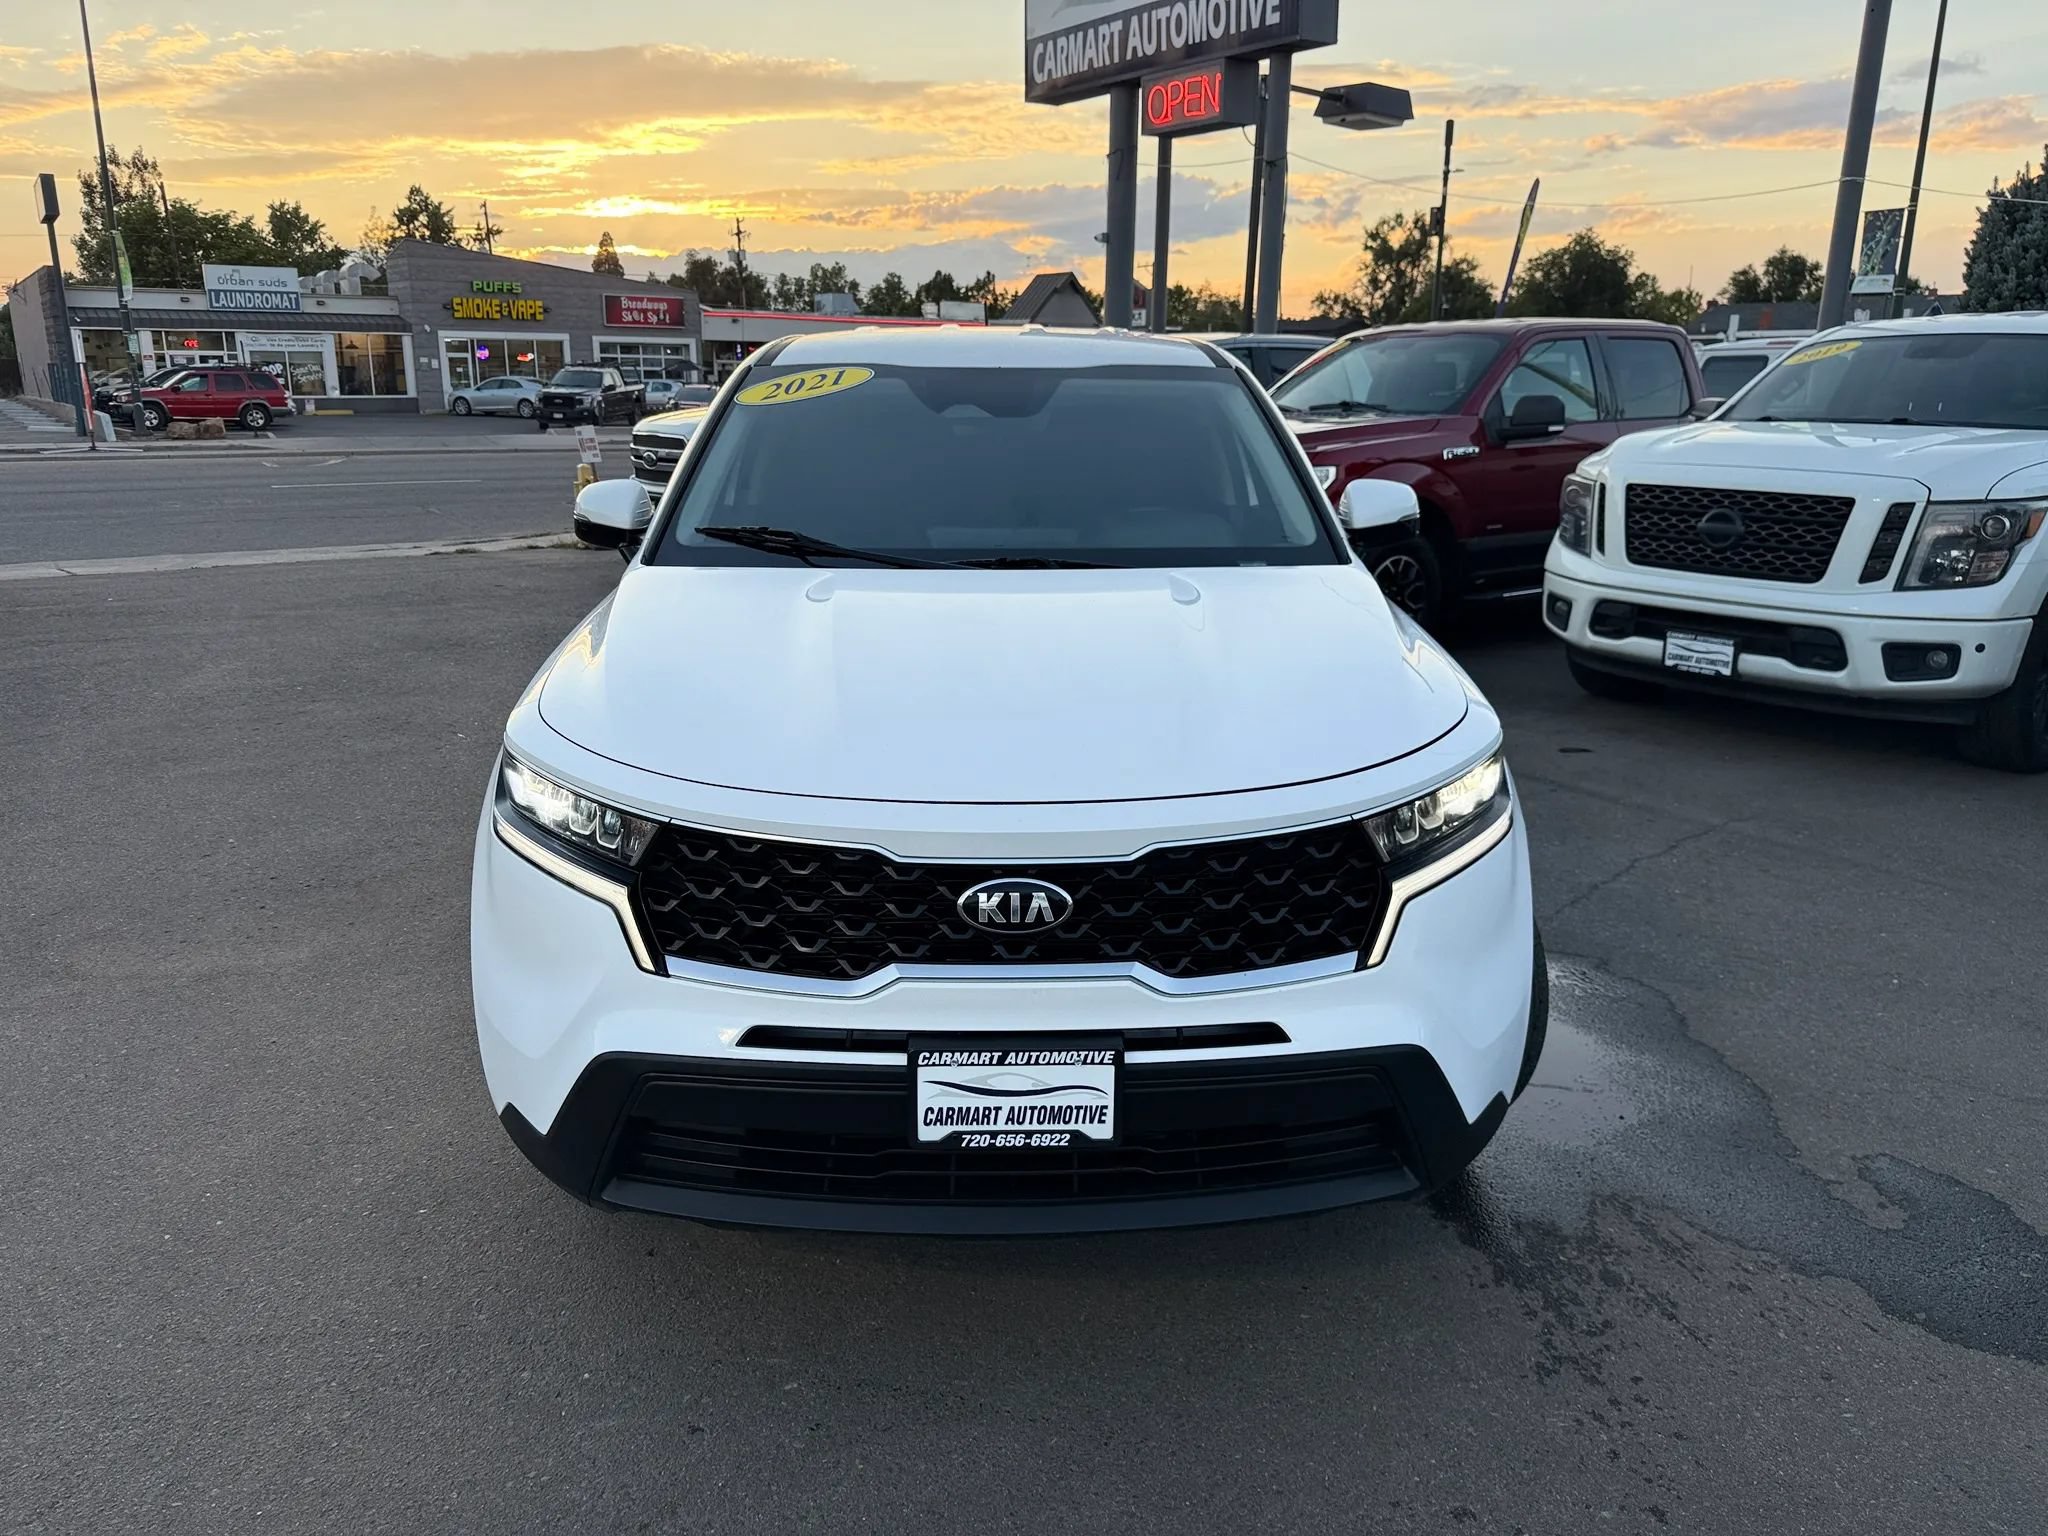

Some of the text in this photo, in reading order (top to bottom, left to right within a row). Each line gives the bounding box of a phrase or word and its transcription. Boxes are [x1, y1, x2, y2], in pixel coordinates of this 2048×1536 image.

[1032, 0, 1281, 84] CARMART AUTOMOTIVE
[1147, 72, 1222, 125] OPEN
[258, 277, 288, 288] suds
[472, 280, 522, 293] PUFFS
[210, 291, 297, 309] LAUNDROMAT
[760, 369, 847, 401] 2021
[977, 892, 1055, 923] KIA
[917, 1051, 1115, 1066] CARMART AUTOMOTIVE
[923, 1105, 1109, 1126] CARMART AUTOMOTIVE
[961, 1133, 1071, 1148] 720-656-6922
